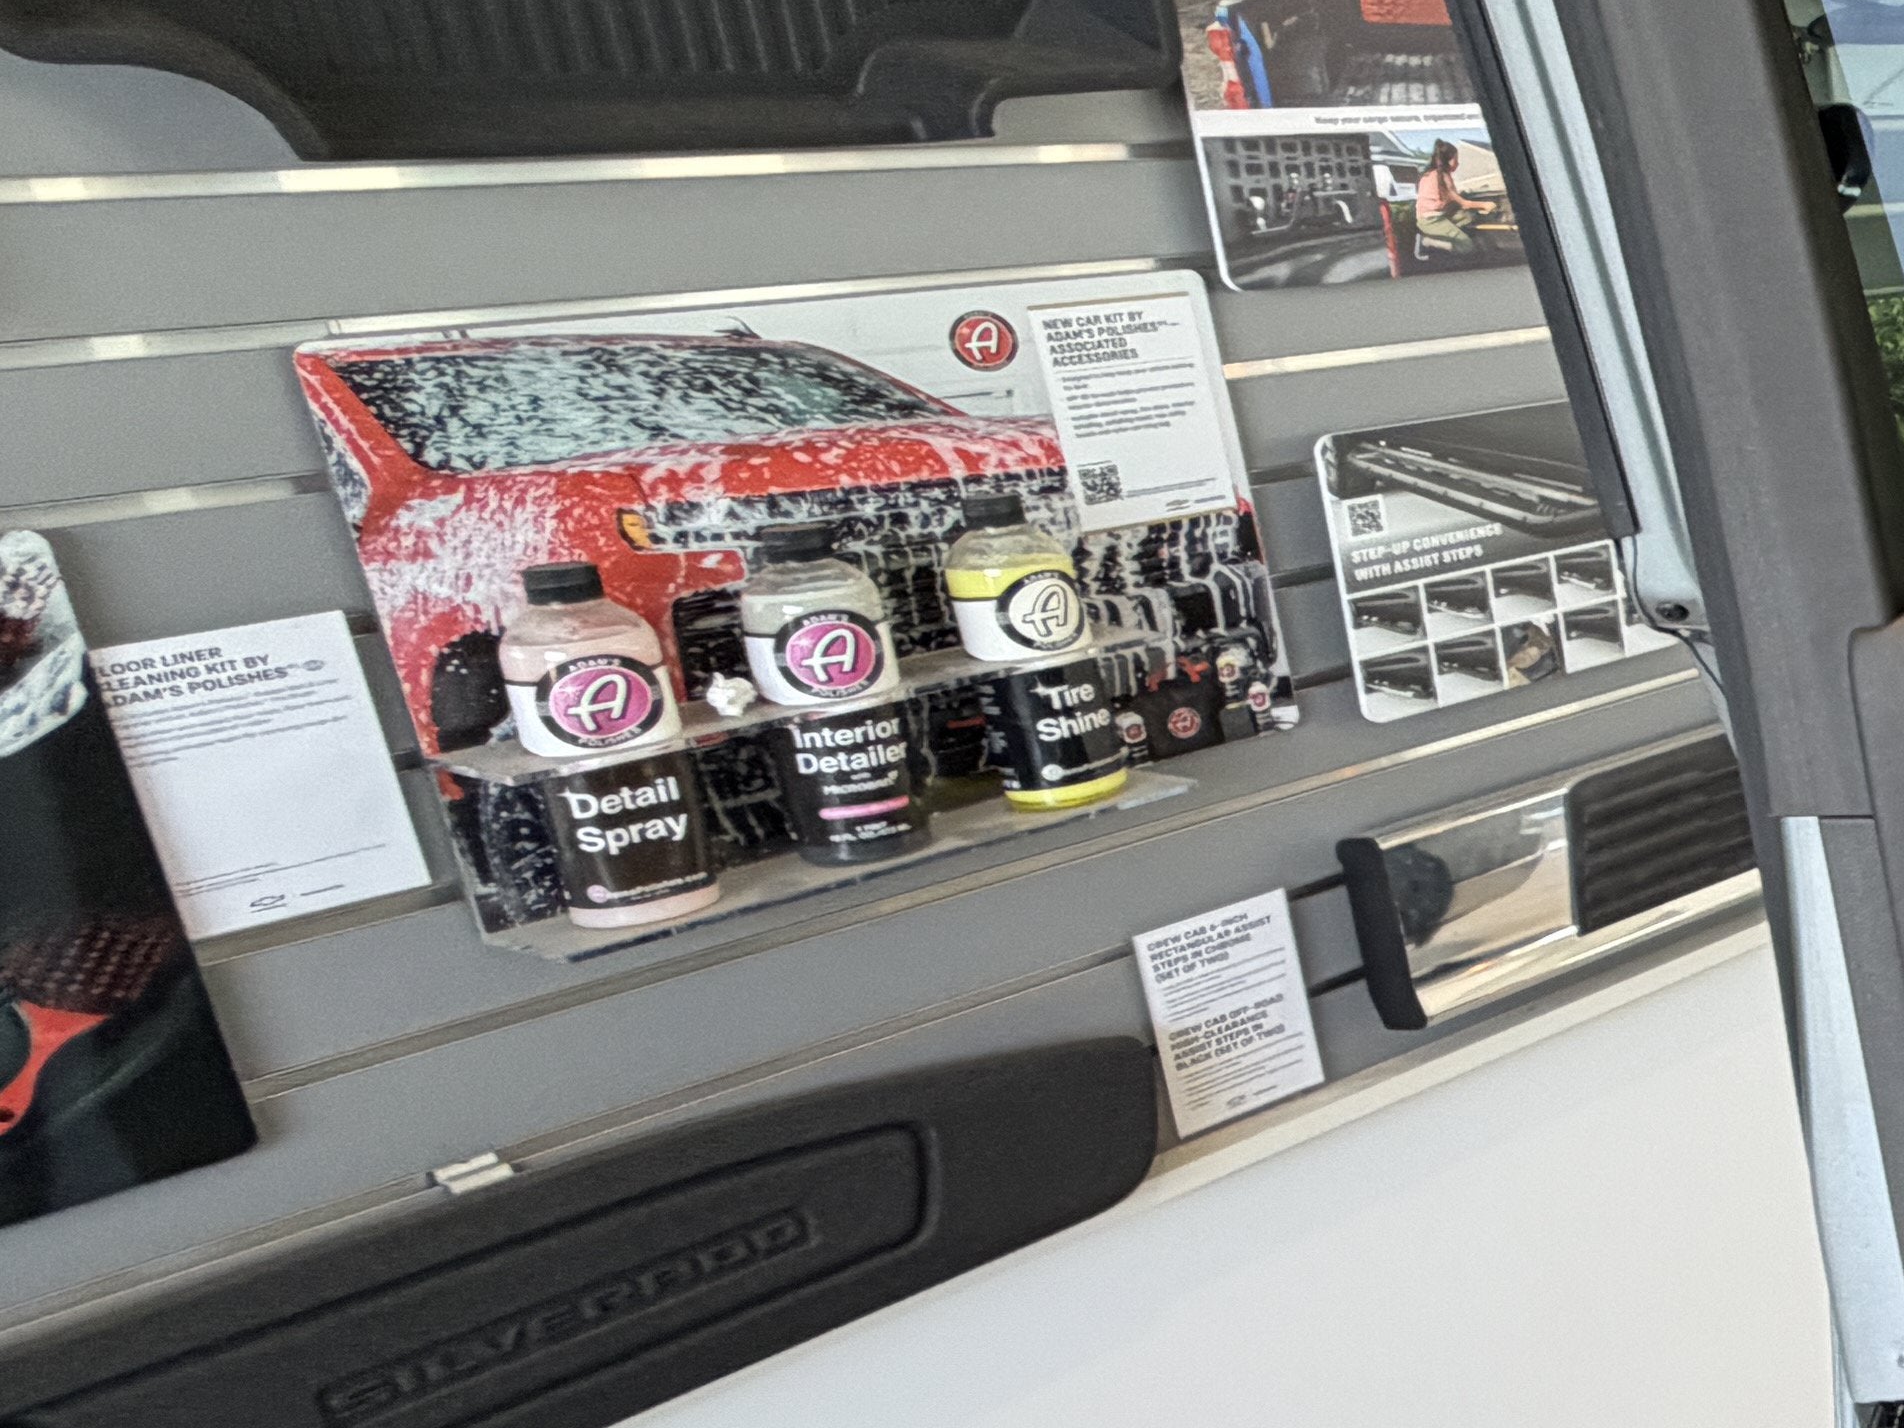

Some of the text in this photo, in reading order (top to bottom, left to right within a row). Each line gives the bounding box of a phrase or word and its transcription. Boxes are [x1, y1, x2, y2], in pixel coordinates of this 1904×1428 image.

[1042, 310, 1143, 330] NEW CAR KIT BY
[1046, 329, 1095, 343] ADAM'S
[1049, 337, 1128, 355] ASSOCIATED
[1052, 348, 1139, 368] ACCESSORIES
[1350, 523, 1503, 564] STEP-UP CONVENIENCE
[1354, 544, 1484, 582] WITH ASSIST STEPS
[97, 646, 224, 678] LOOR LINER
[204, 658, 239, 675] KIT
[242, 654, 269, 670] BY
[801, 628, 856, 683] A
[566, 673, 628, 732] A
[1046, 683, 1096, 710] Tire
[789, 717, 900, 749] Interior
[1036, 708, 1112, 742] Shine
[795, 741, 908, 775] Detailer
[565, 776, 681, 820] Detail
[576, 813, 689, 856] Spray
[1152, 954, 1189, 973] STEPS
[319, 1207, 815, 1421] SILVERADO
